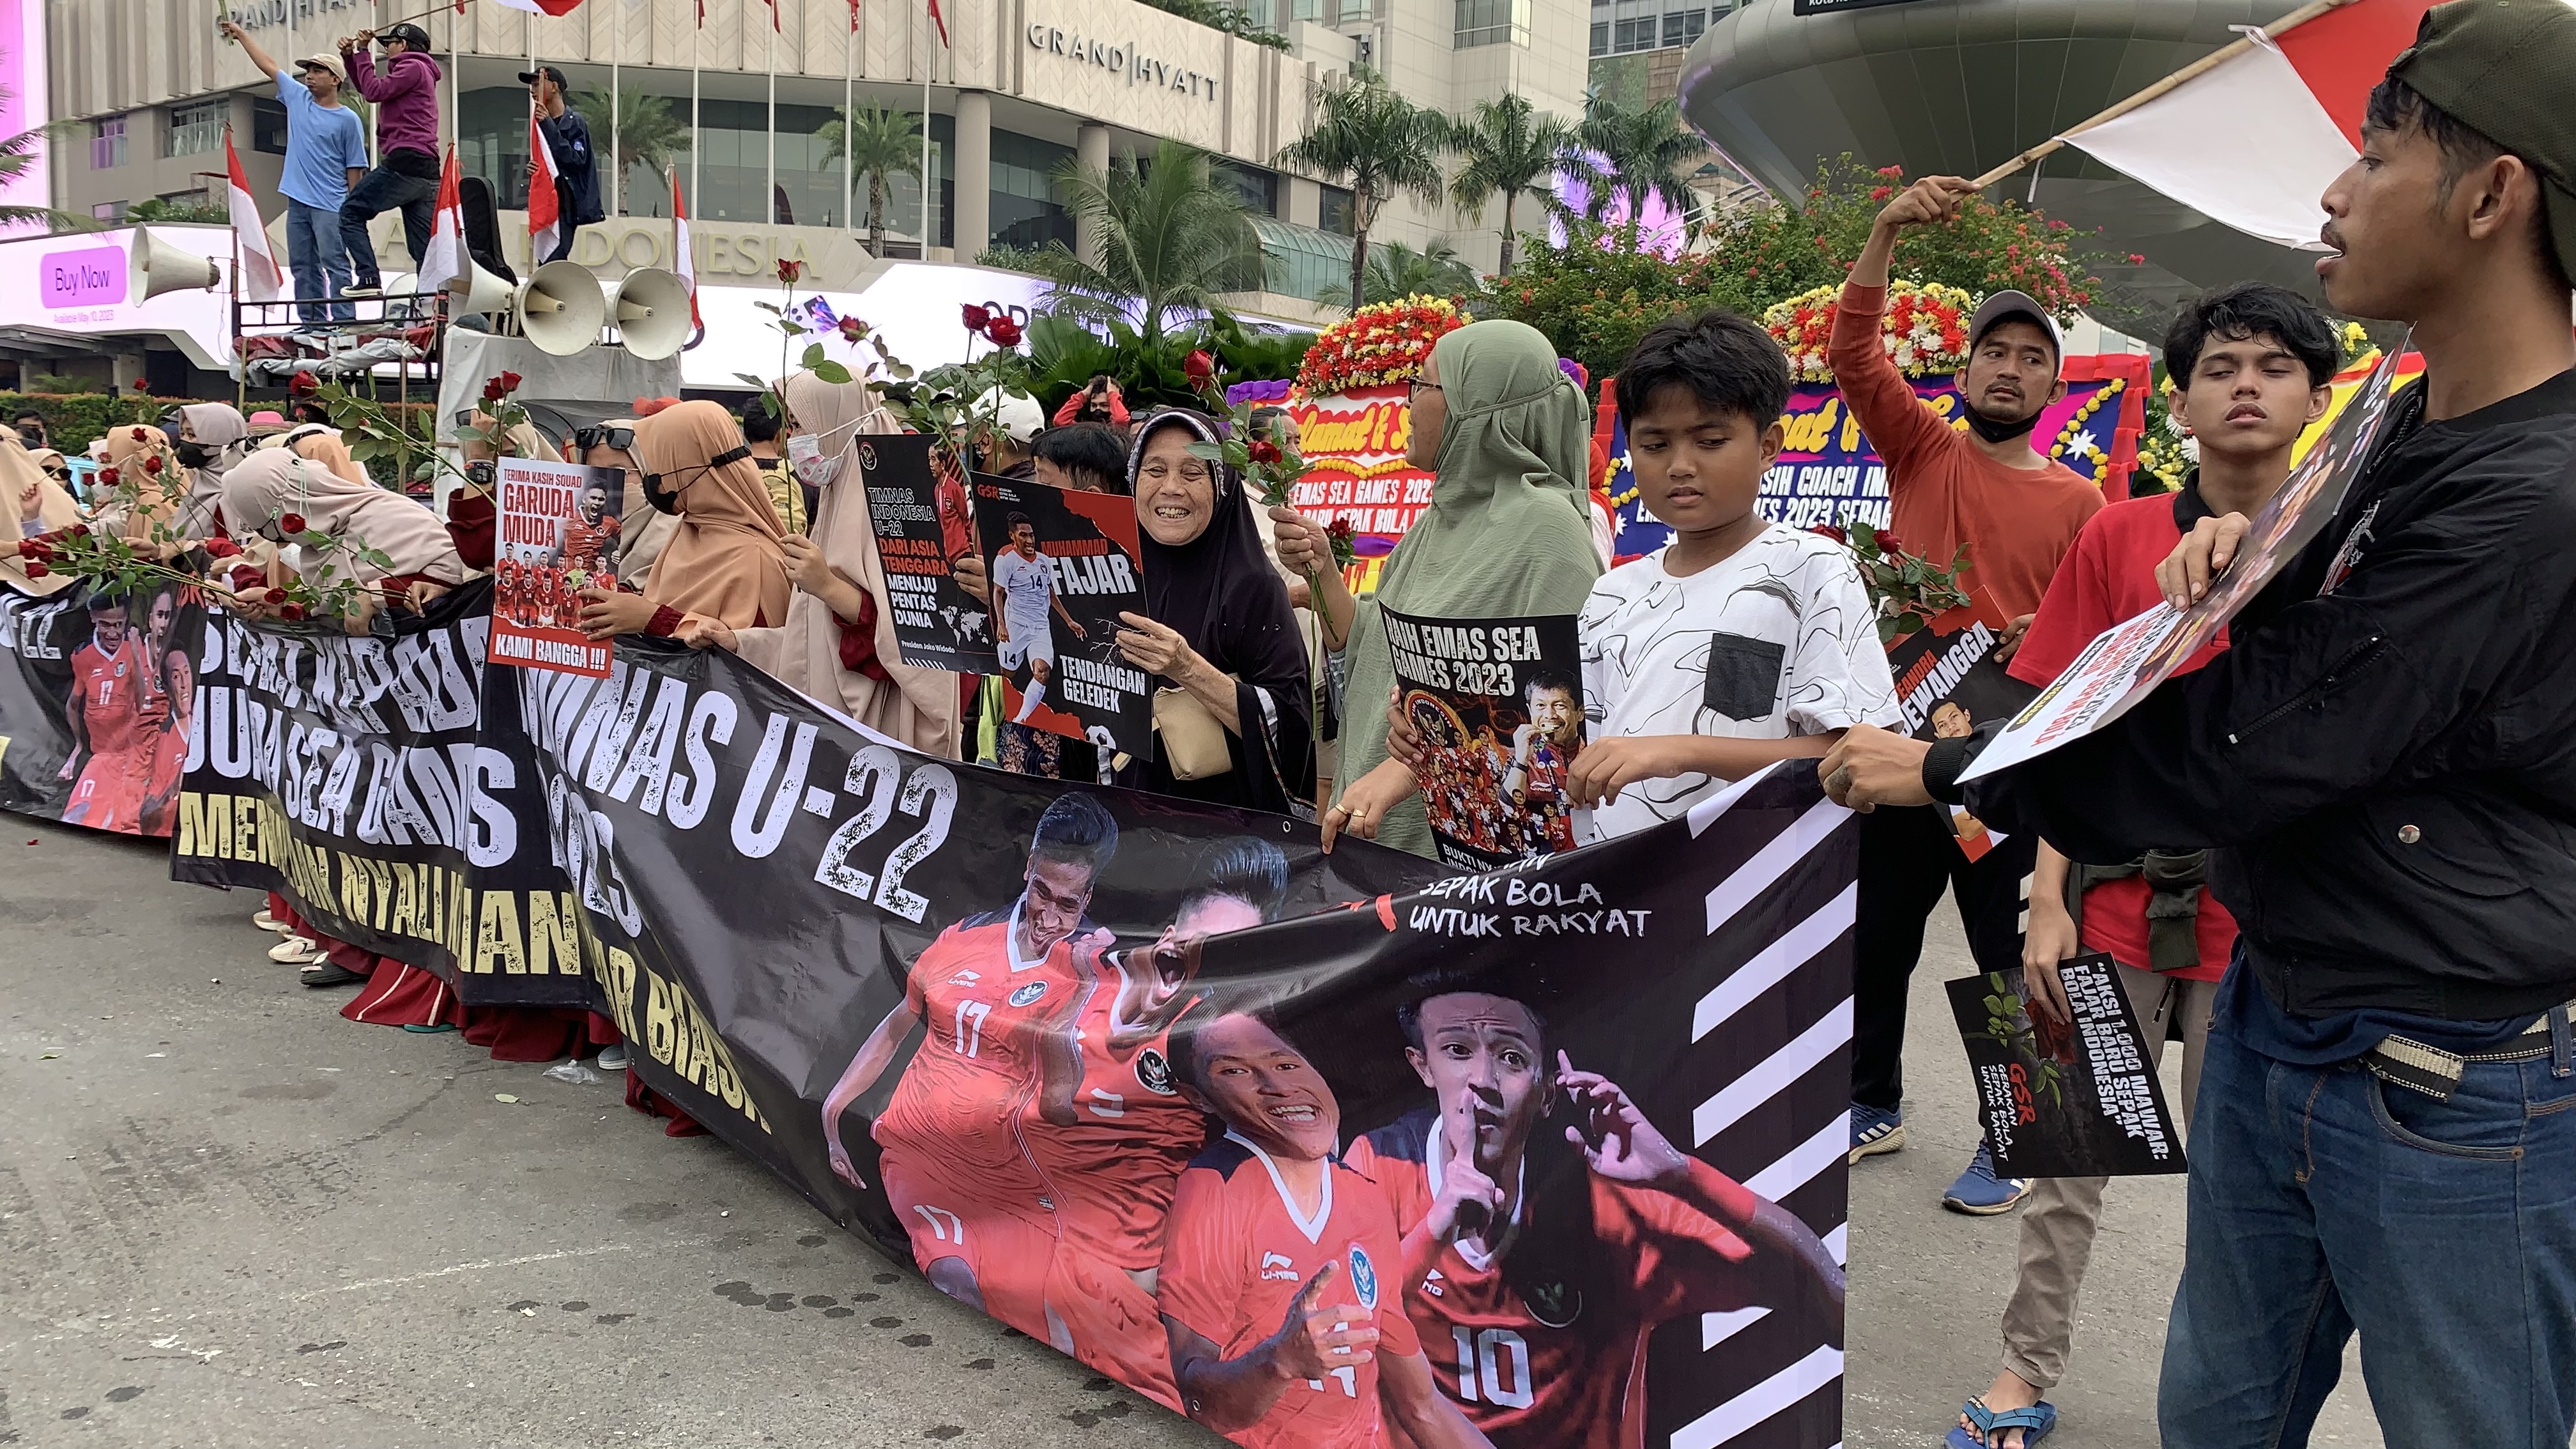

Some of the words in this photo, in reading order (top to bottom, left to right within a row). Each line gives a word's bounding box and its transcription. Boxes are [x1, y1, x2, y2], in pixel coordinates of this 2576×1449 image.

[1029, 23, 1124, 72] GRAND
[1137, 55, 1218, 101] HYATT
[518, 222, 822, 279] IDOESIA
[56, 268, 78, 296] Buy
[81, 264, 110, 288] Now
[504, 468, 532, 484] TERIMA
[532, 473, 554, 486] KASIH
[556, 475, 582, 488] SQUAD
[977, 484, 1000, 501] GSR
[1328, 480, 1353, 505] SEA
[1354, 479, 1401, 505] GAMES
[1798, 466, 1854, 496] COACH
[503, 483, 574, 519] GARUDA
[868, 487, 914, 504] TIMNAS
[871, 504, 936, 522] INDONESIA
[875, 521, 904, 536] U-22
[1374, 509, 1409, 534] BOLA
[1784, 498, 1834, 530] 2023
[503, 514, 556, 548] MUDA
[878, 538, 908, 555] DARI
[911, 540, 940, 557] ASIA
[1041, 539, 1108, 556] MUHAMMAD
[882, 556, 951, 576] TENGGARA
[1030, 575, 1043, 590] 14
[1050, 554, 1137, 595] FAJAR
[887, 574, 937, 594] MENUJU
[891, 592, 937, 611] PENTAS
[894, 609, 934, 629] DUNIA
[494, 634, 533, 661] KAMI
[535, 638, 587, 670] BANGGA
[590, 647, 606, 671] !!!
[901, 640, 923, 650] Presiden
[936, 645, 955, 654] Widodo
[1384, 611, 1422, 654] RAIH
[1421, 625, 1488, 662] EMAS
[1492, 625, 1542, 661] SEA
[1004, 650, 1016, 666] 14
[1392, 645, 1451, 690] GAMES
[1452, 661, 1515, 697] 2023
[1896, 649, 1939, 700] EANDRA
[2096, 648, 2147, 696] GAMES
[99, 680, 113, 705] 17
[1059, 655, 1145, 696] TENDANGAN
[1062, 678, 1121, 713] GELEDEK
[2060, 673, 2113, 715] SEPAK
[2030, 712, 2074, 747] BOLA
[80, 779, 95, 798] 17
[286, 722, 360, 837] SEA
[730, 710, 959, 924] U-22
[1443, 843, 1477, 868] BUKTI
[1506, 878, 1604, 907] BOLA
[1409, 905, 1502, 939] UNTUK
[1511, 909, 1652, 938] RAKYAT
[2060, 967, 2088, 1014] BOLA
[954, 999, 992, 1059] 17
[2074, 965, 2106, 1019] FAJAR
[2096, 1023, 2126, 1073] BARU
[2113, 1077, 2145, 1138] SEPAK
[1989, 1064, 2005, 1106] SEPAK
[1999, 1109, 2013, 1146] BOLA
[1998, 1064, 2018, 1126] GERAKAN
[2009, 1063, 2036, 1126] GSR
[2111, 1018, 2143, 1071] 1.000
[2129, 1075, 2169, 1160] MAWAR:
[1981, 1066, 1997, 1108] UNTUK
[1990, 1110, 2009, 1162] RAKYAT
[914, 1204, 963, 1245] 17
[1451, 1326, 1535, 1409] 10
